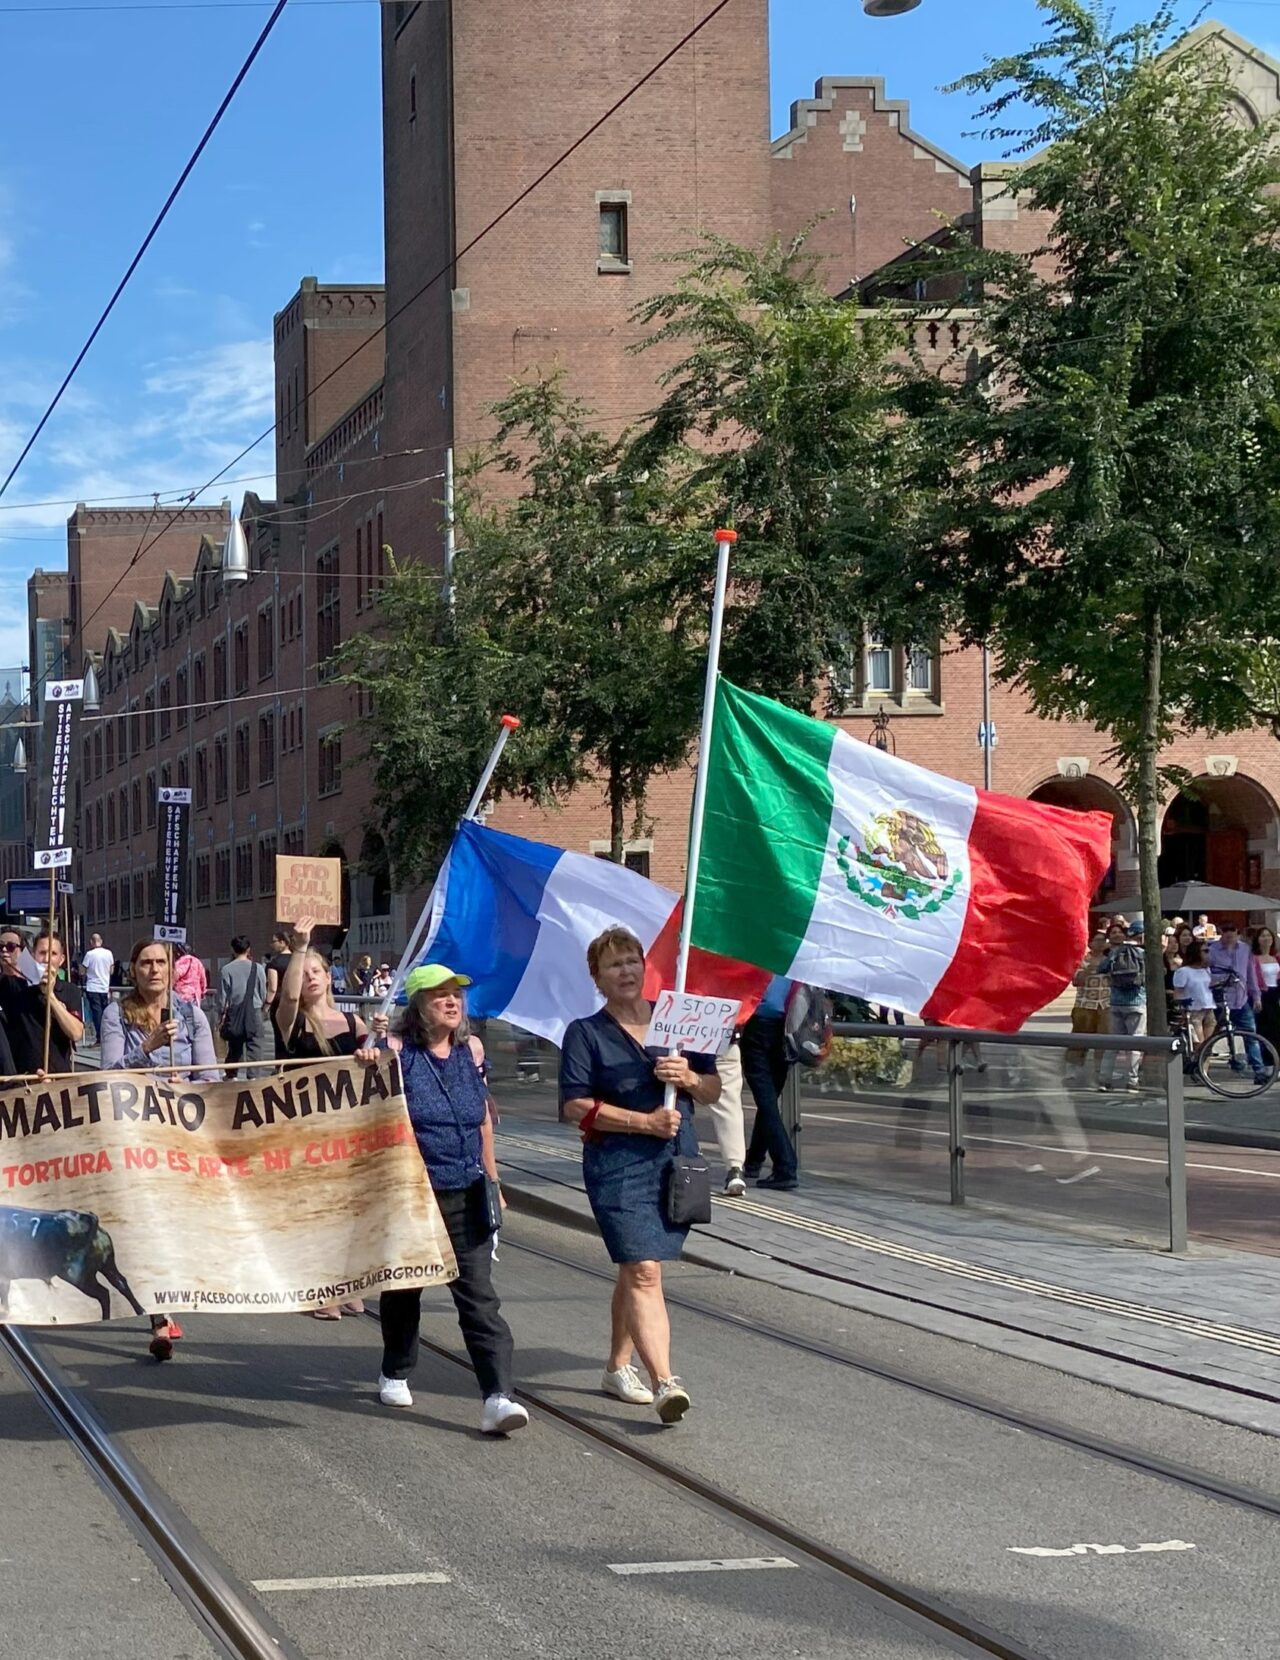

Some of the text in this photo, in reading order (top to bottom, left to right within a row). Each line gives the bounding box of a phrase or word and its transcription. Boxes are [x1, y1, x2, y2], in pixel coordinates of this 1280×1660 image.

[48, 703, 65, 847] STIERENVECHTEN
[57, 703, 72, 846] AFSCHAFFEN!
[164, 805, 173, 923] STIERENVECHTEN
[171, 805, 181, 923] AFSCHAFFEN!
[654, 1021, 734, 1039] BULLFIGHTS
[681, 998, 732, 1017] STOP
[2, 1150, 113, 1188] TORTURA
[123, 1147, 159, 1170] NO
[166, 1150, 192, 1173] ES
[197, 1154, 255, 1178] ARTE
[304, 1122, 411, 1166] CULTURA
